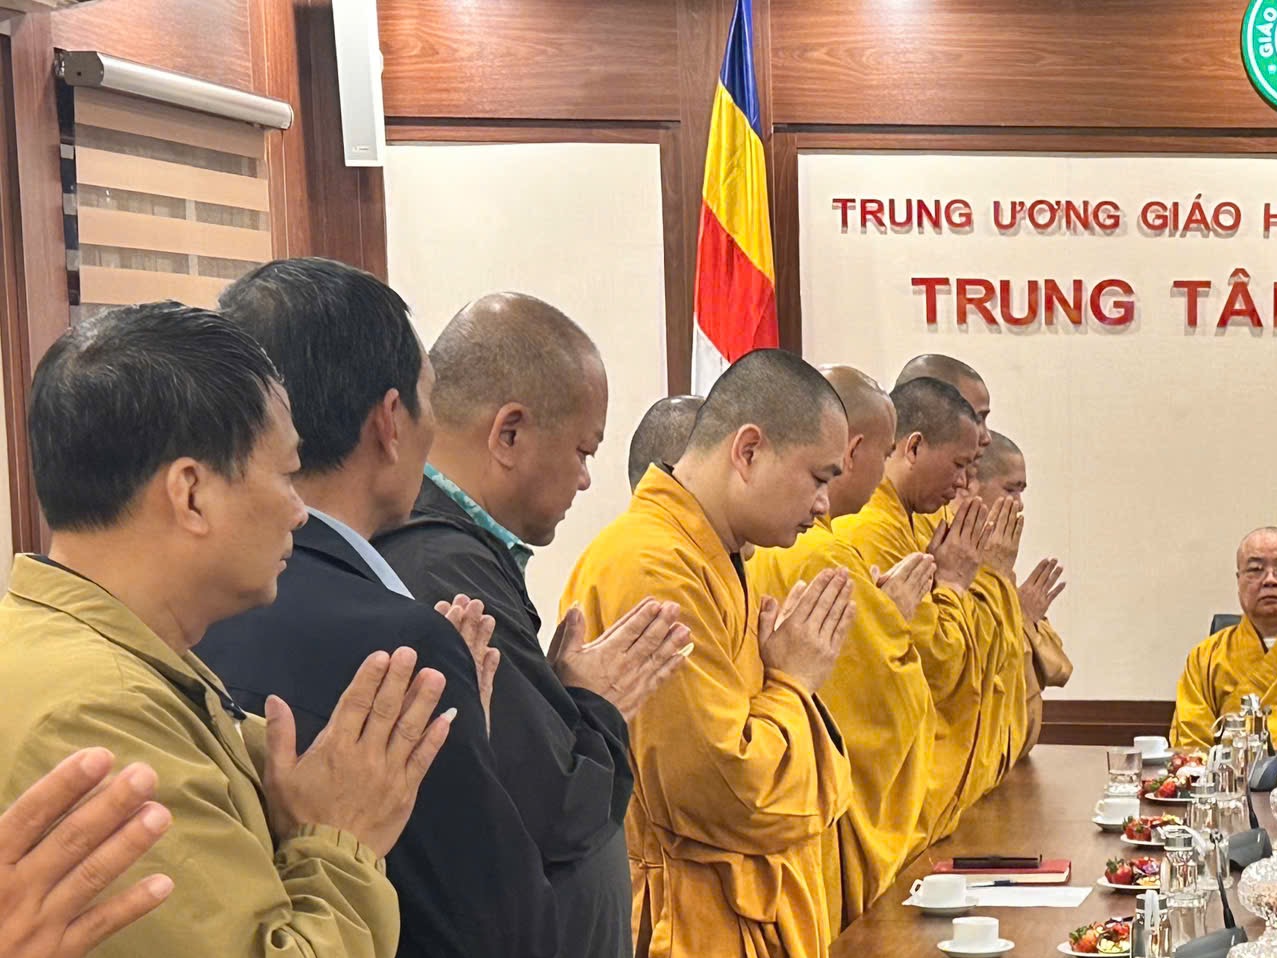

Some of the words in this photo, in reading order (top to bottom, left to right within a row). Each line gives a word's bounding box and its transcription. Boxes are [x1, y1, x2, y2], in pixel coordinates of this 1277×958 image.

[832, 197, 972, 229] TRUNG
[993, 199, 1121, 231] ƯƠNG
[1141, 193, 1242, 232] GIÁO
[911, 277, 1135, 328] TRUNG
